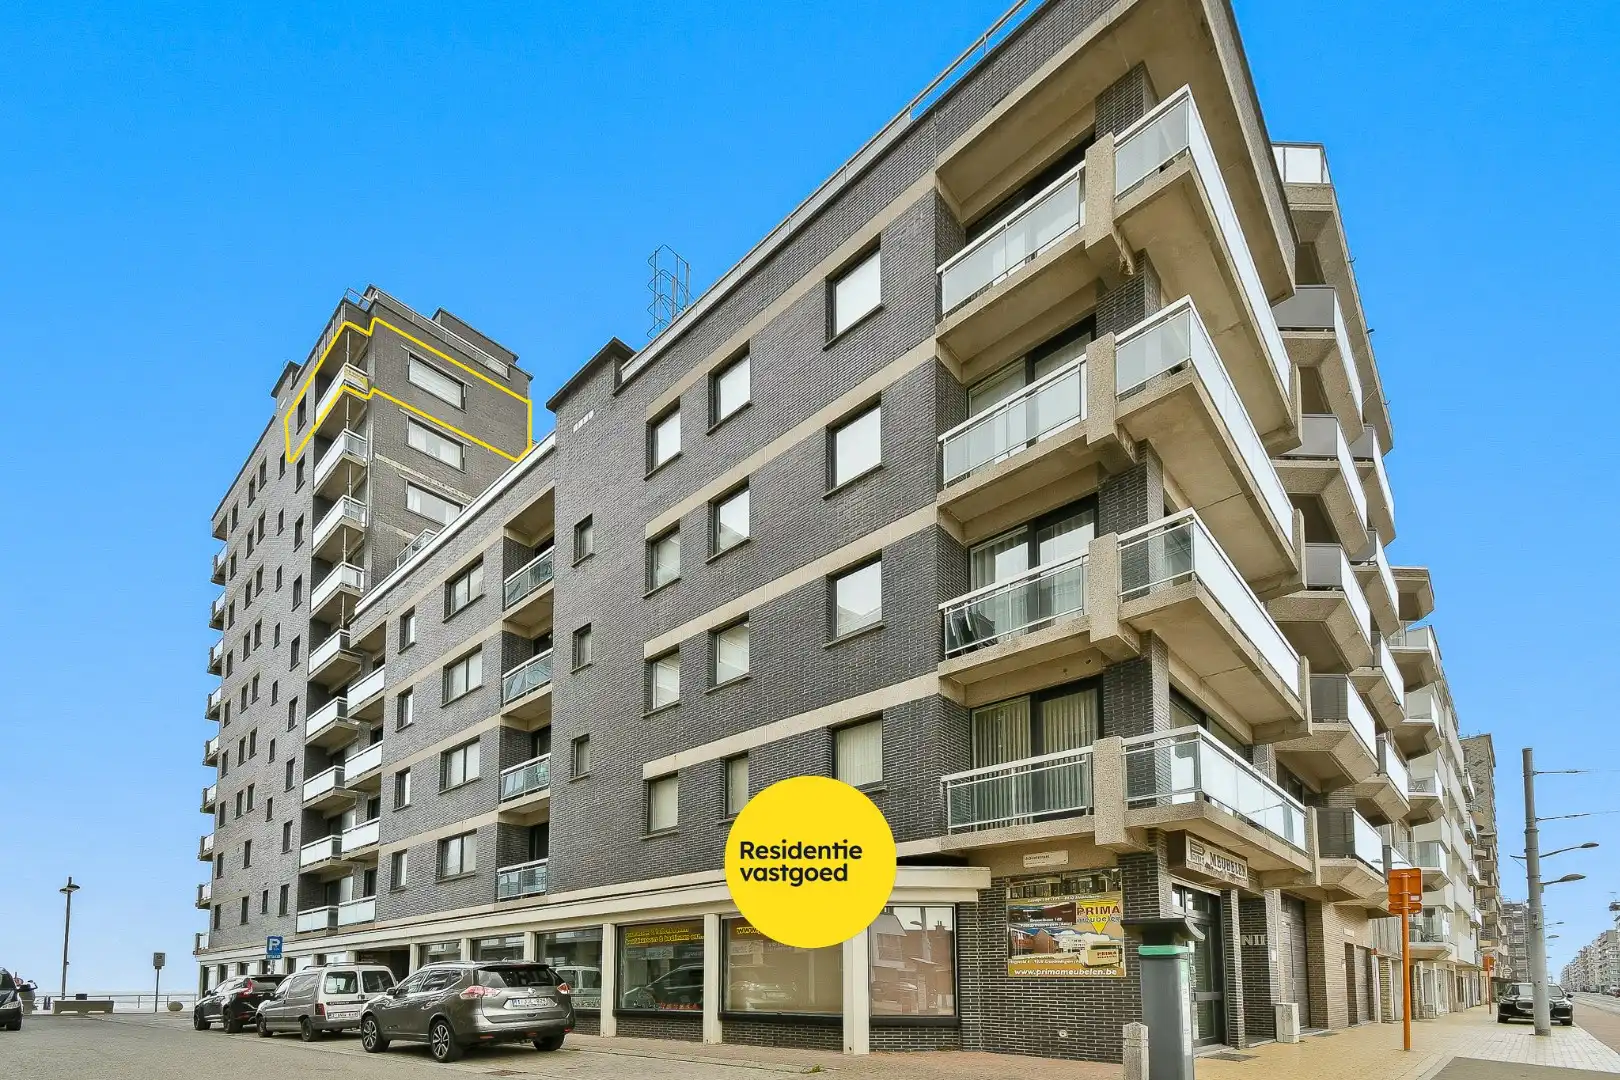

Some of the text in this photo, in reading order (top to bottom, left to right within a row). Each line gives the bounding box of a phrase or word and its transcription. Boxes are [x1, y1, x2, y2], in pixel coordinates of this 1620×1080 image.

[1209, 851, 1247, 878] MEUBELEN
[1077, 905, 1120, 915] PRIMA
[268, 938, 281, 951] P
[1014, 968, 1117, 976] www.primameubelen.be
